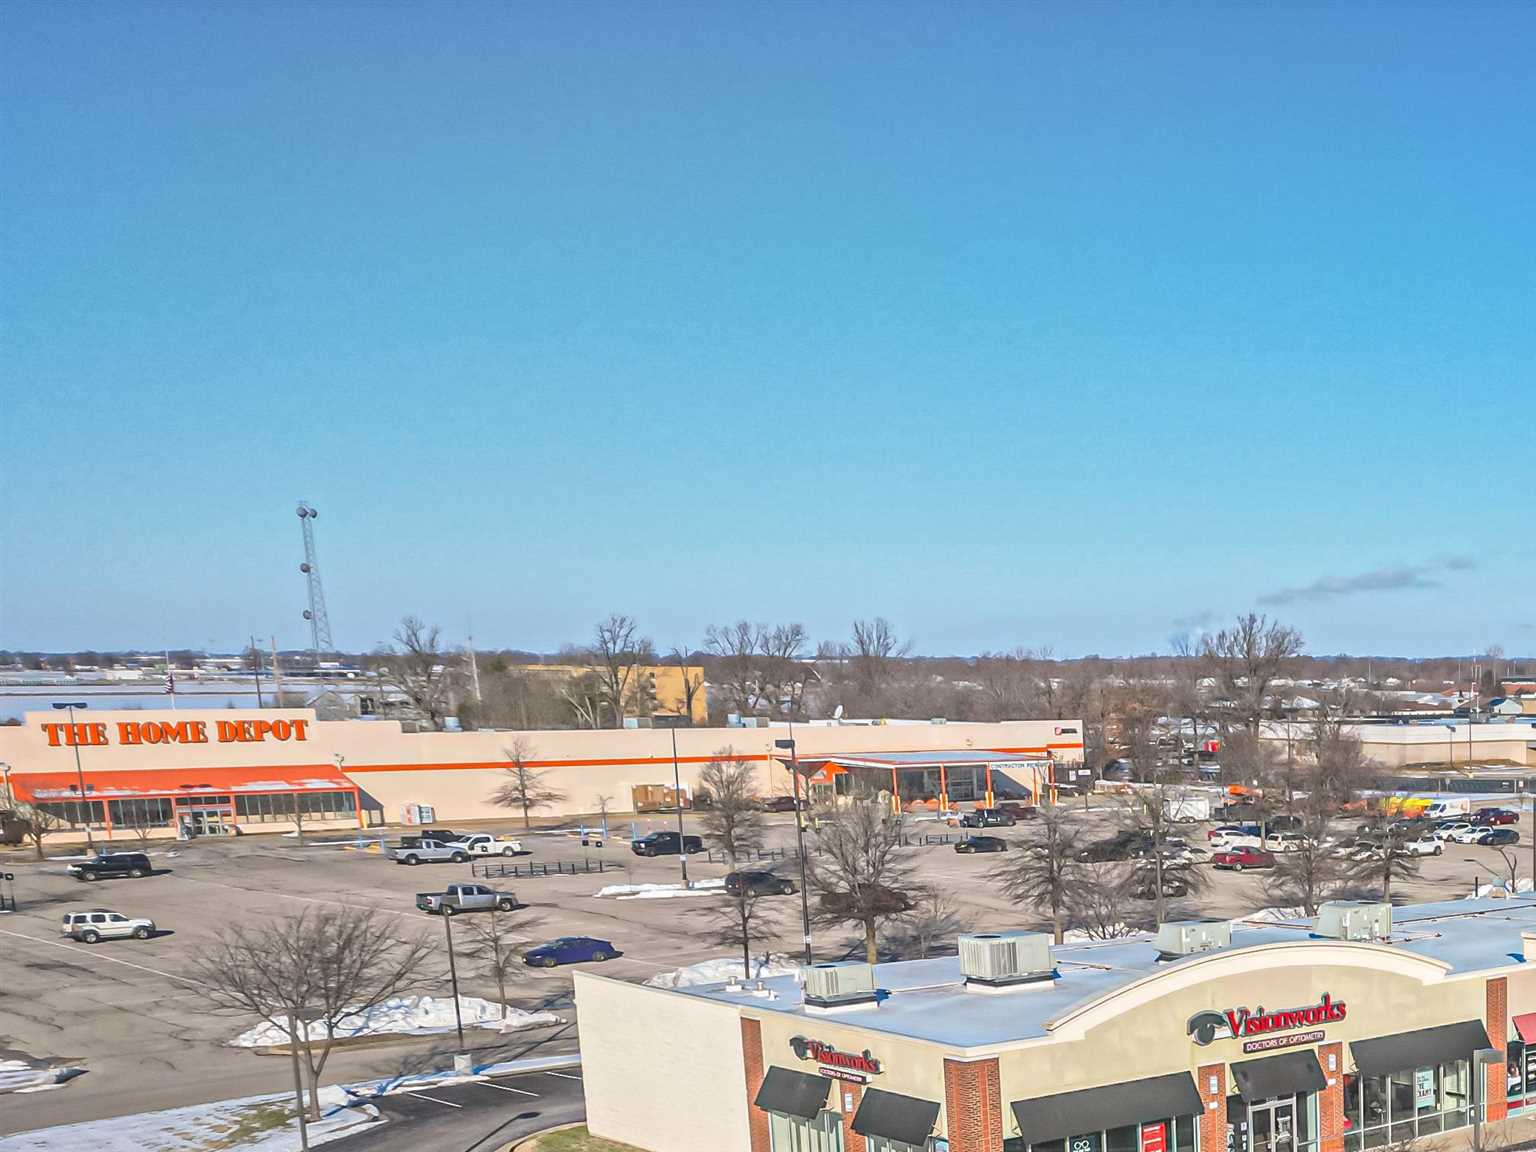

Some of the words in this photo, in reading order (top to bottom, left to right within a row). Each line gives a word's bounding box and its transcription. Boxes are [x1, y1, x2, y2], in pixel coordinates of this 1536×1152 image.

[41, 723, 108, 746] THE
[116, 720, 207, 745] HOME
[215, 719, 309, 743] DEPOT
[1224, 992, 1346, 1040] Visionworks
[1246, 1040, 1277, 1051] DOCTORS
[1279, 1037, 1289, 1046] OF
[1289, 1031, 1324, 1044] OPTOMETRY
